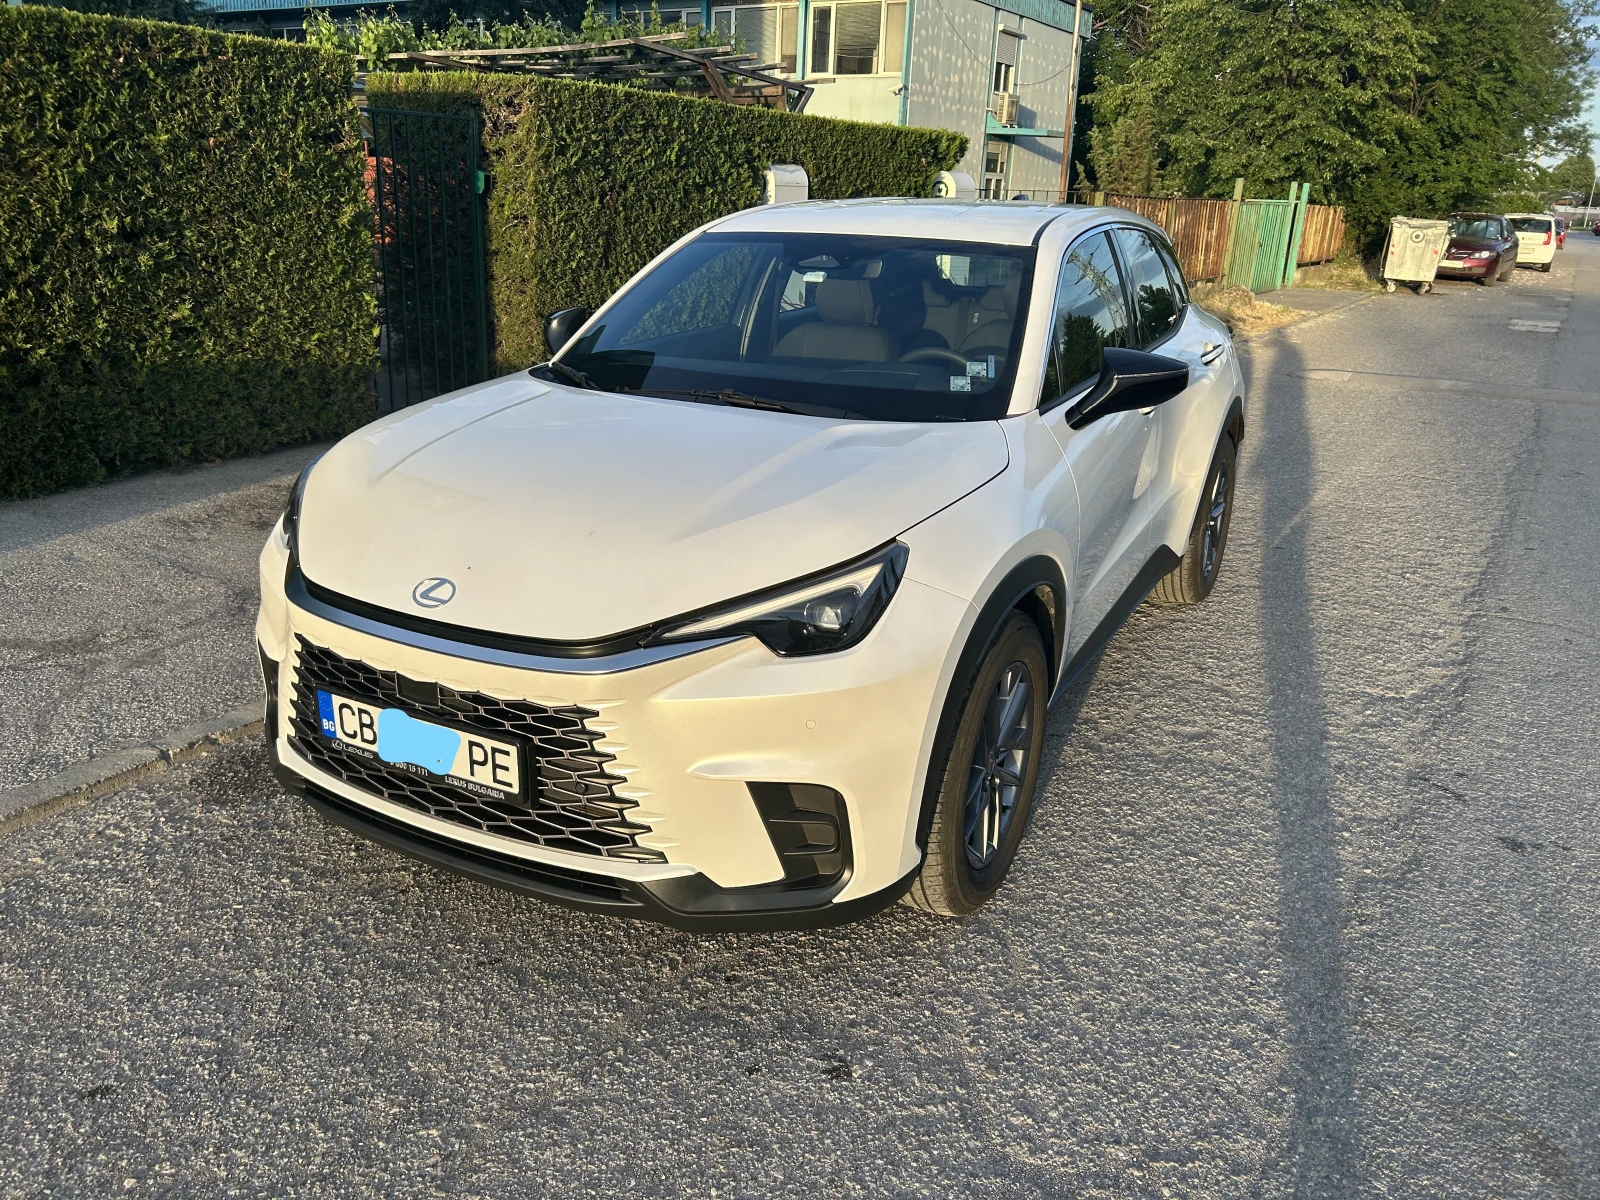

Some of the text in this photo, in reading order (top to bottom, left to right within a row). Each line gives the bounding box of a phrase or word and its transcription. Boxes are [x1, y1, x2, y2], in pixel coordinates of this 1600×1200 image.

[322, 718, 335, 732] BG
[338, 702, 513, 788] CB PE
[343, 744, 374, 759] LEXUS
[409, 764, 416, 773] 15
[445, 775, 505, 799] LEXUS BULGARIA
